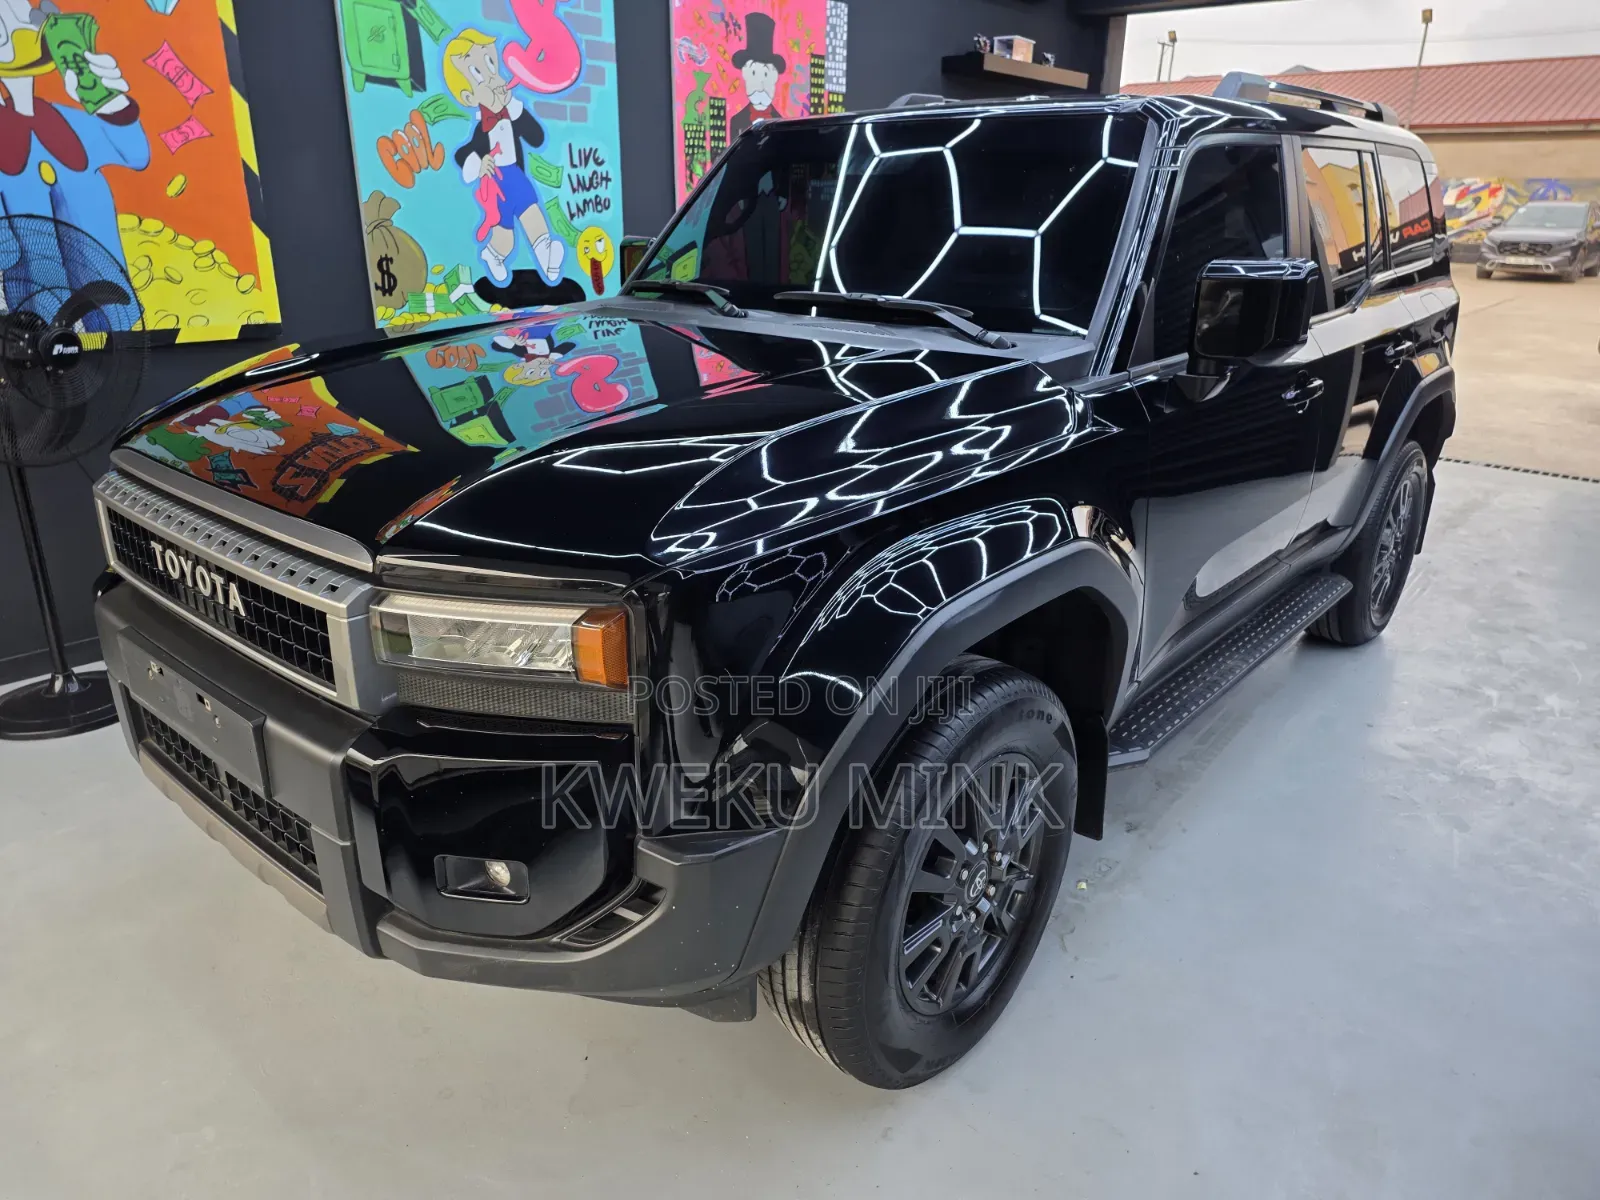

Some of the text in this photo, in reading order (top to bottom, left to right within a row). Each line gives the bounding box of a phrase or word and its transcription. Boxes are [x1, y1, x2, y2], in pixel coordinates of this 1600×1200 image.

[376, 109, 446, 189] COOL
[568, 143, 604, 169] LIVE
[567, 170, 612, 195] LAUGH
[566, 195, 611, 221] LAMBO
[150, 540, 247, 617] TOYOTA
